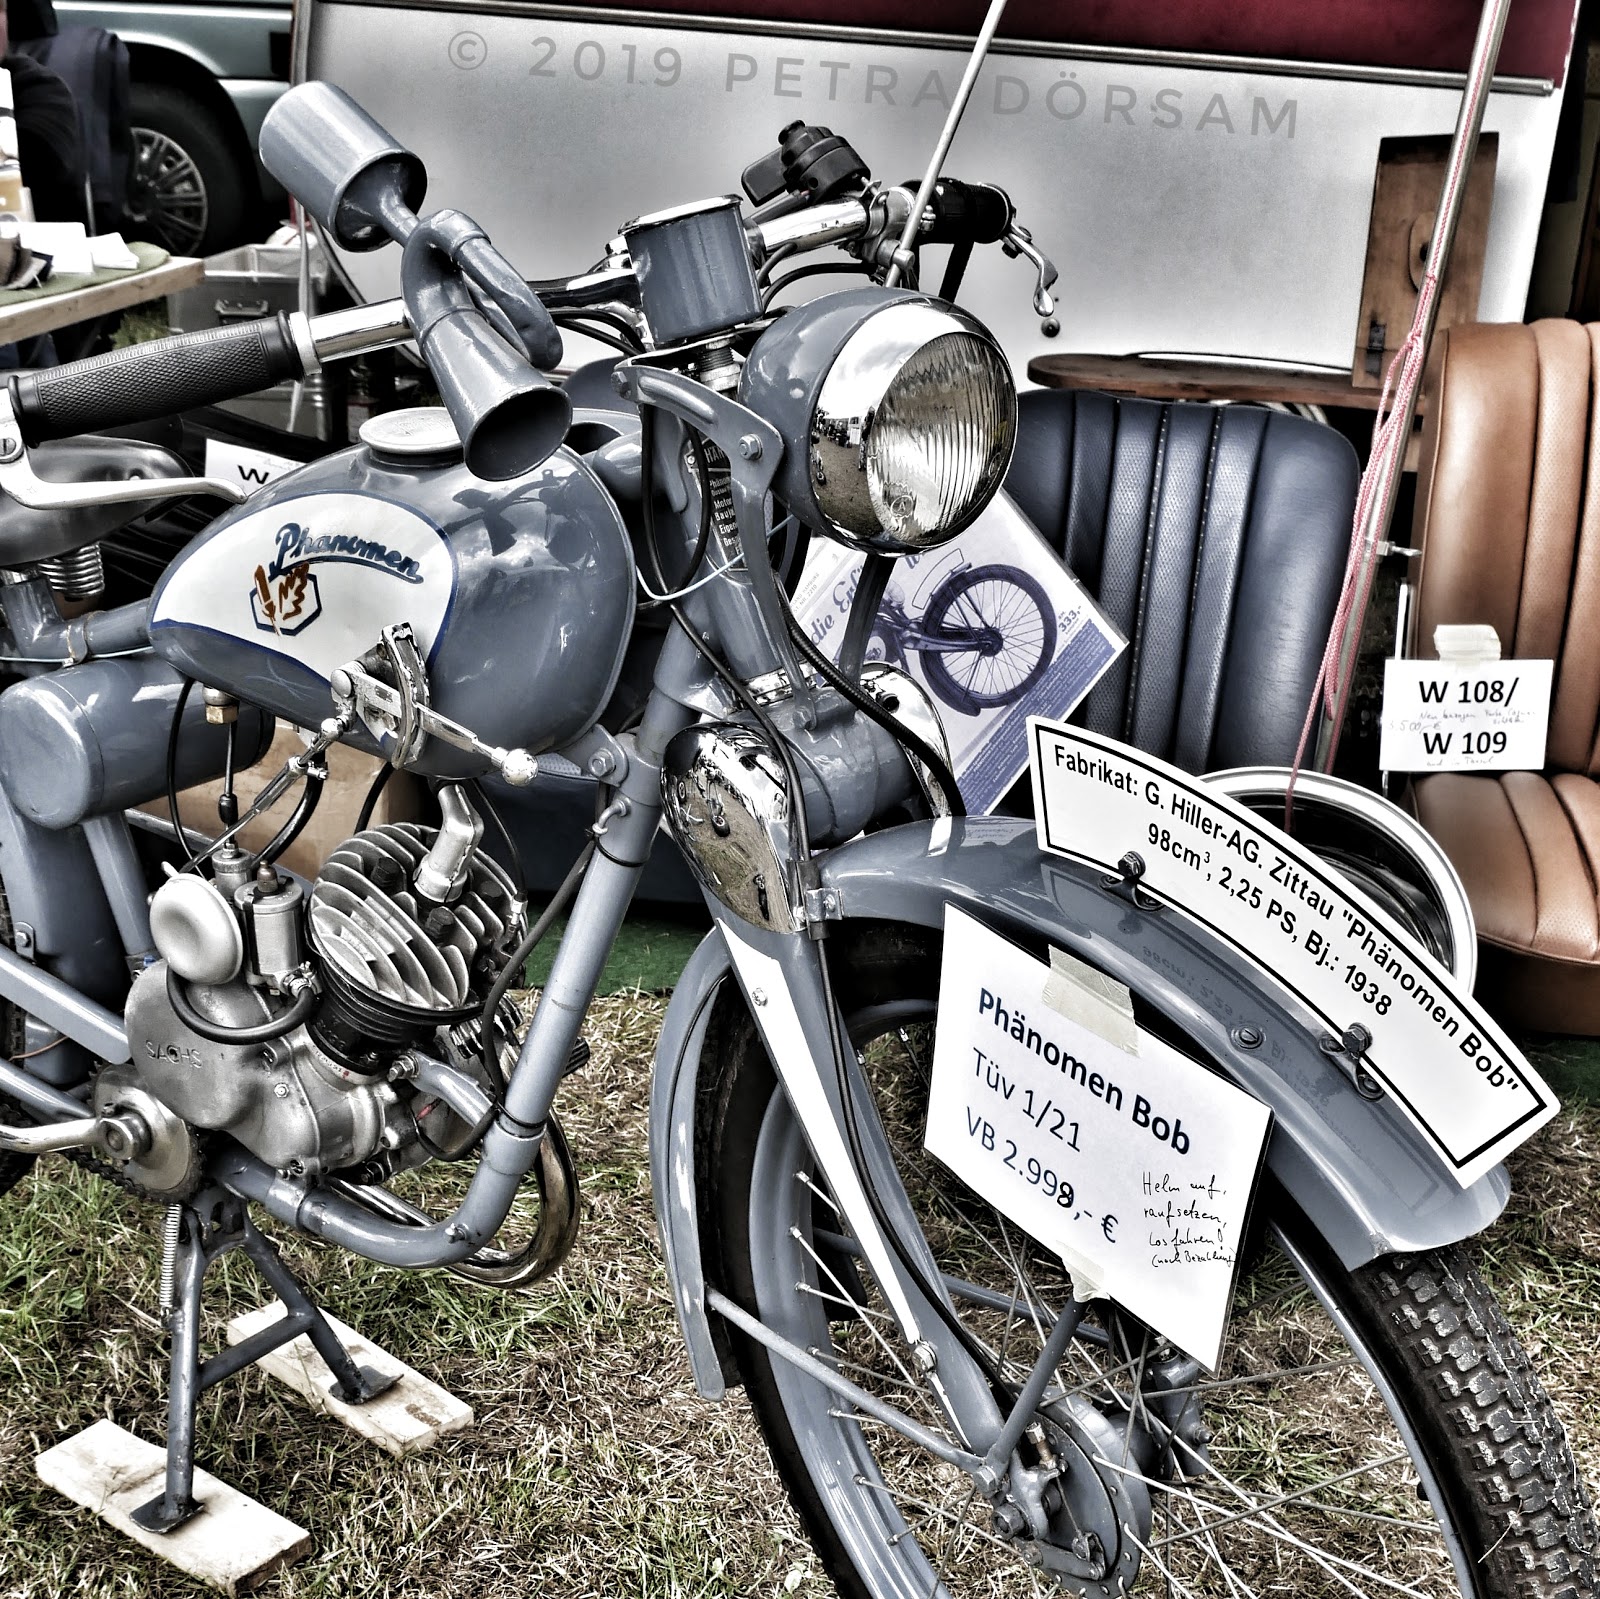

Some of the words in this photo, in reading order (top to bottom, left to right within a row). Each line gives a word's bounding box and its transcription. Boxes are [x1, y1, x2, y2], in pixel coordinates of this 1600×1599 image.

[237, 465, 269, 484] W
[810, 614, 835, 646] die
[1419, 681, 1449, 703] W
[1458, 677, 1520, 707] 108/
[1423, 732, 1453, 754] W
[1461, 731, 1508, 755] 109
[1054, 745, 1139, 798] Fabrikat:
[1145, 781, 1166, 812] G.
[1171, 795, 1262, 869] Hiller-AG.
[1269, 856, 1335, 921] Zittau
[1218, 866, 1263, 911] 2,25
[1265, 900, 1300, 943] PS,
[1304, 929, 1340, 972] Bj.:
[1344, 964, 1393, 1017] 1938
[145, 1039, 204, 1069] SACHS
[978, 987, 1123, 1110] Phänomen
[1131, 1094, 1191, 1155] Bob
[972, 1047, 1016, 1101] Tüv
[1022, 1089, 1082, 1153] 1/21
[966, 1105, 996, 1152] VB
[1100, 1213, 1119, 1244] €
[1142, 1171, 1180, 1196] Helm
